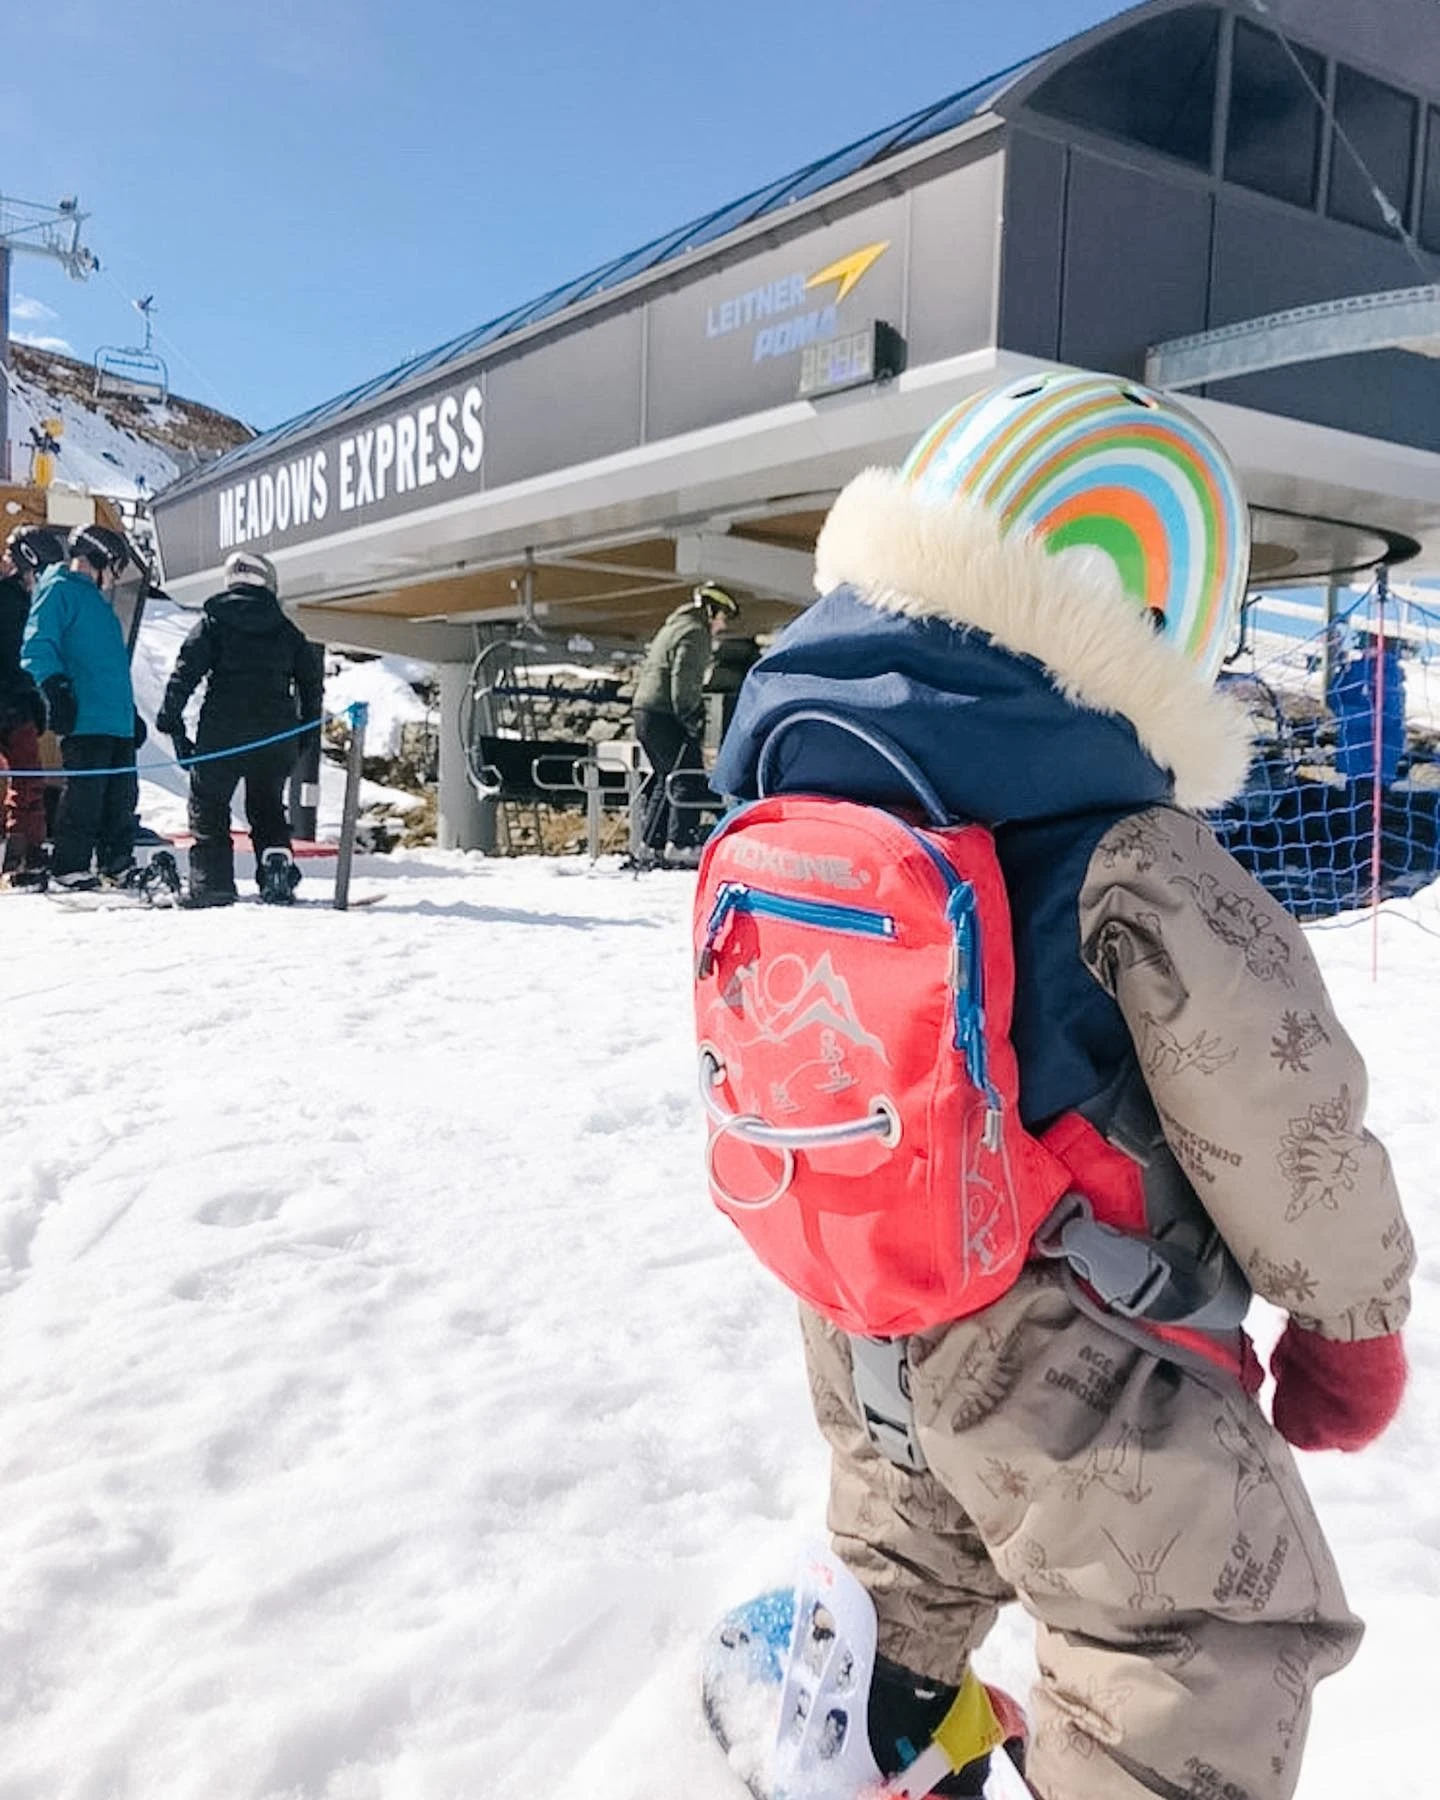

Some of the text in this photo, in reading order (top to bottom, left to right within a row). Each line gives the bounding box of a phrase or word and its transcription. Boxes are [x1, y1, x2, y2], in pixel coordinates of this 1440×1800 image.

[219, 386, 484, 549] MEADOWS EXPRESS
[1231, 1530, 1252, 1560] OF
[1236, 1556, 1264, 1598] THE
